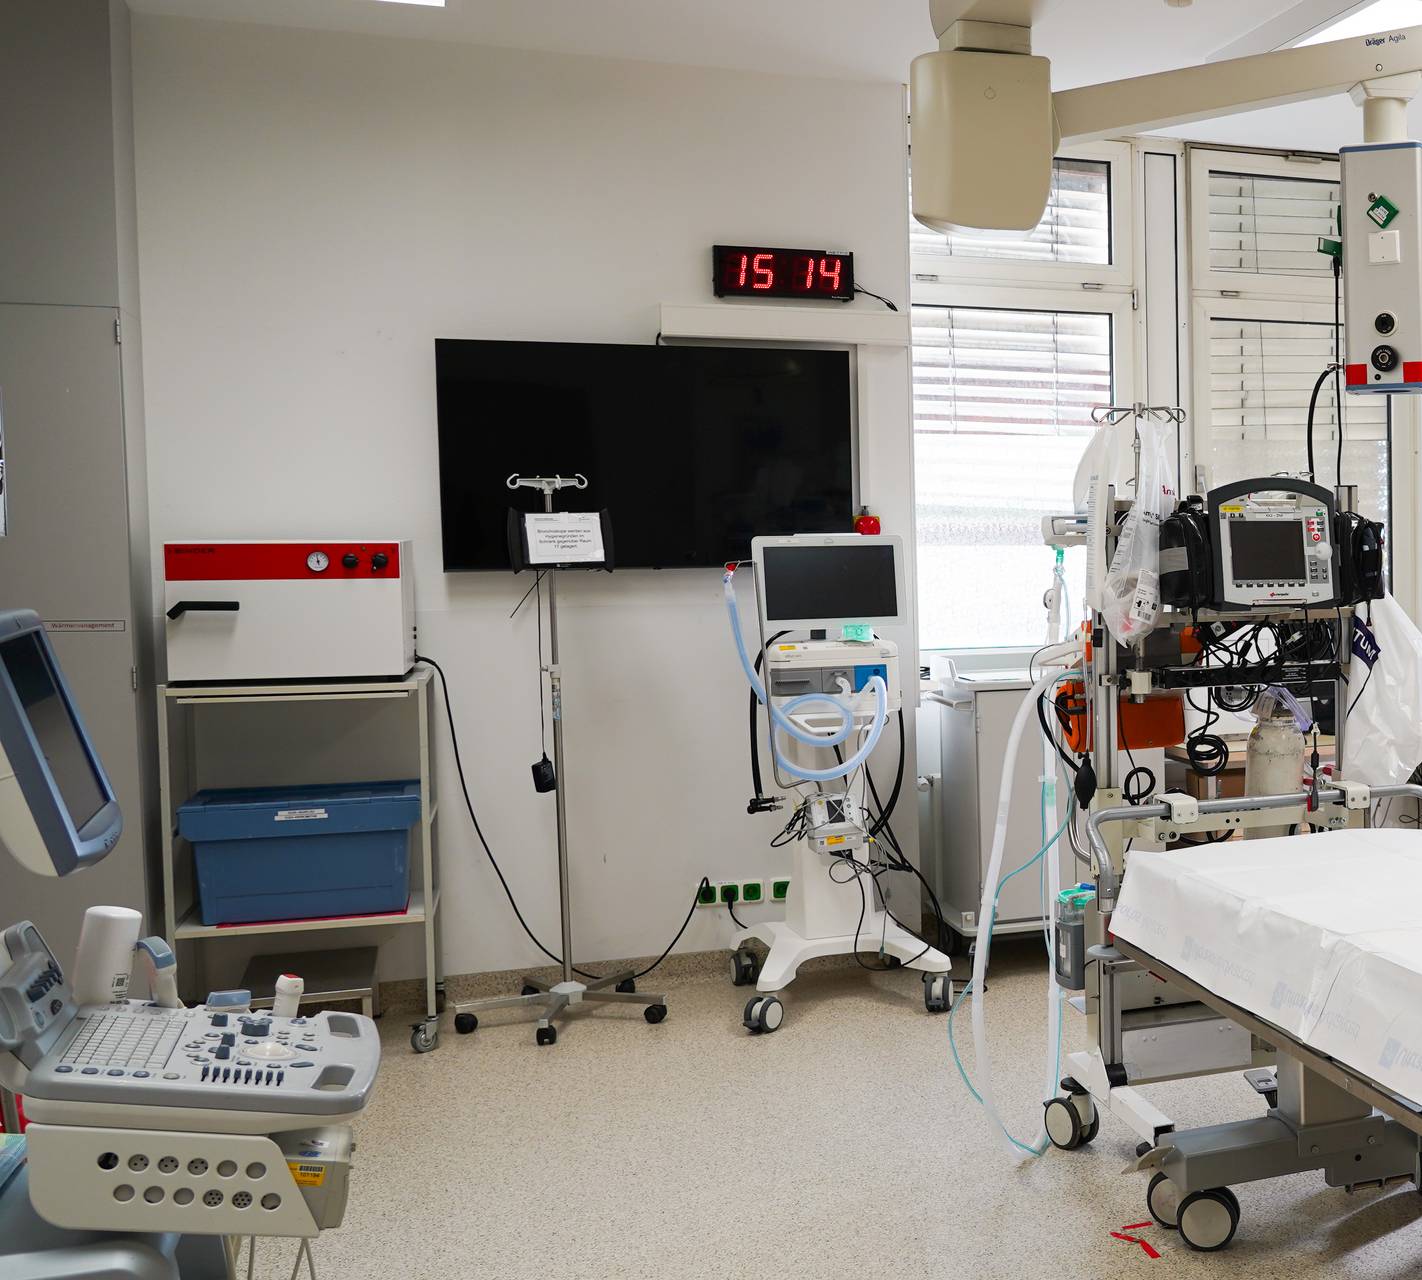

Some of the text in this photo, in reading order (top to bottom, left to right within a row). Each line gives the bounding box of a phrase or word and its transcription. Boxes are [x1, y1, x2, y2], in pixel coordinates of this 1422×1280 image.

[739, 254, 841, 290] 15 14
[1353, 628, 1376, 660] TUM
